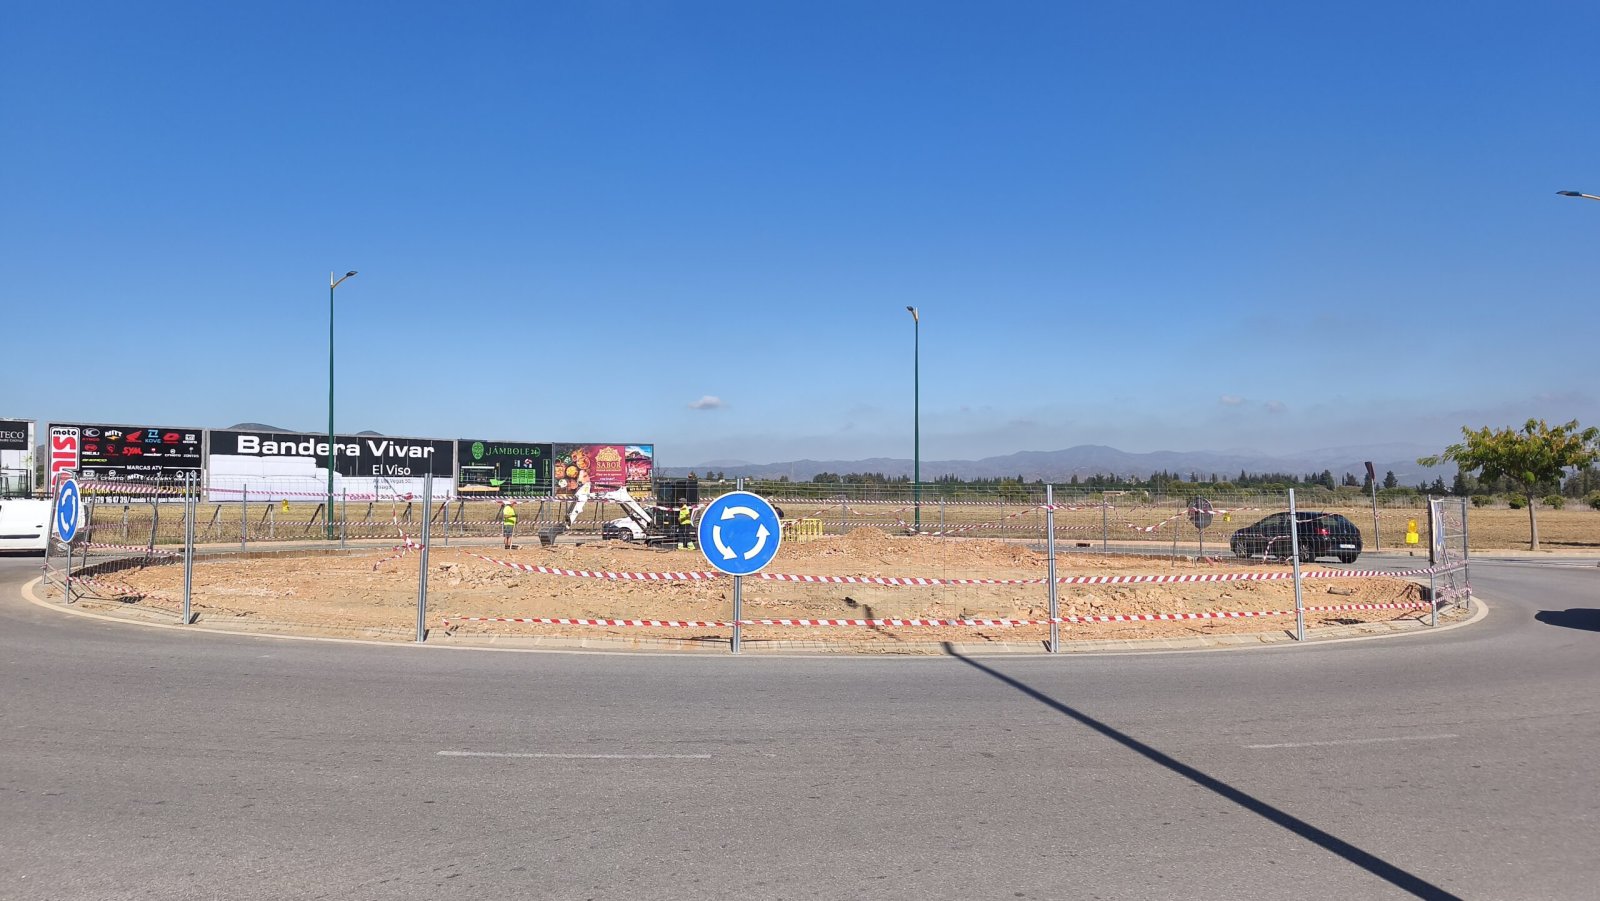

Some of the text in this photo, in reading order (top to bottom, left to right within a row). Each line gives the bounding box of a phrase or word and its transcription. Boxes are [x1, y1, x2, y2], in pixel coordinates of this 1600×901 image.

[237, 435, 435, 458] Bandera Vivar
[372, 464, 411, 475] El Viso
[596, 461, 621, 469] SABOR
